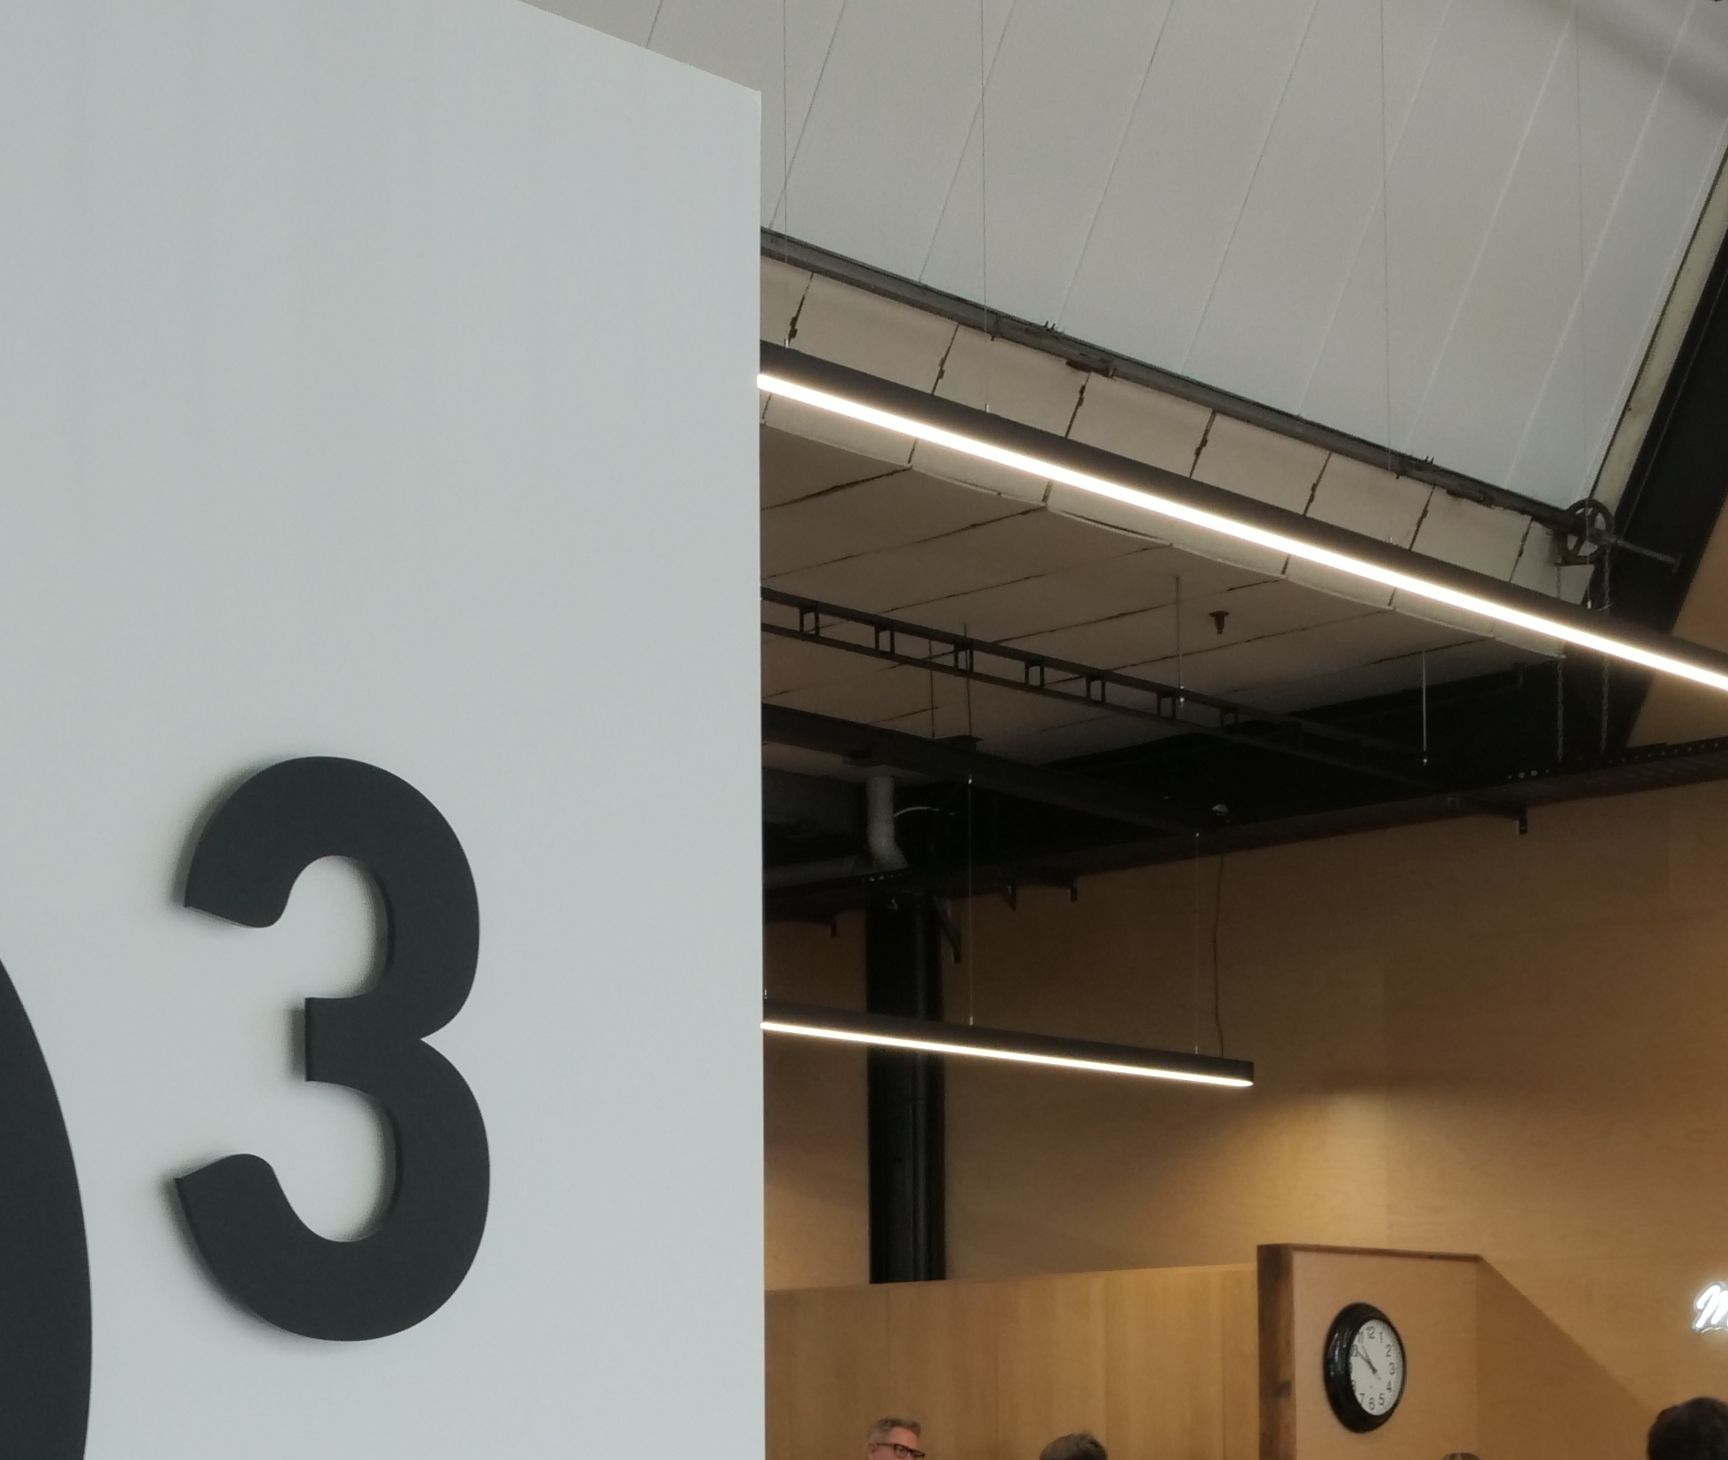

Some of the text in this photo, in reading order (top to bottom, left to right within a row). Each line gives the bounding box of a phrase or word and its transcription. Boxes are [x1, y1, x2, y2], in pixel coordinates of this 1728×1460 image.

[1385, 1344, 1392, 1358] 2
[1388, 1362, 1396, 1376] 3
[1368, 1397, 1376, 1411] 6
[1378, 1393, 1385, 1406] 5
